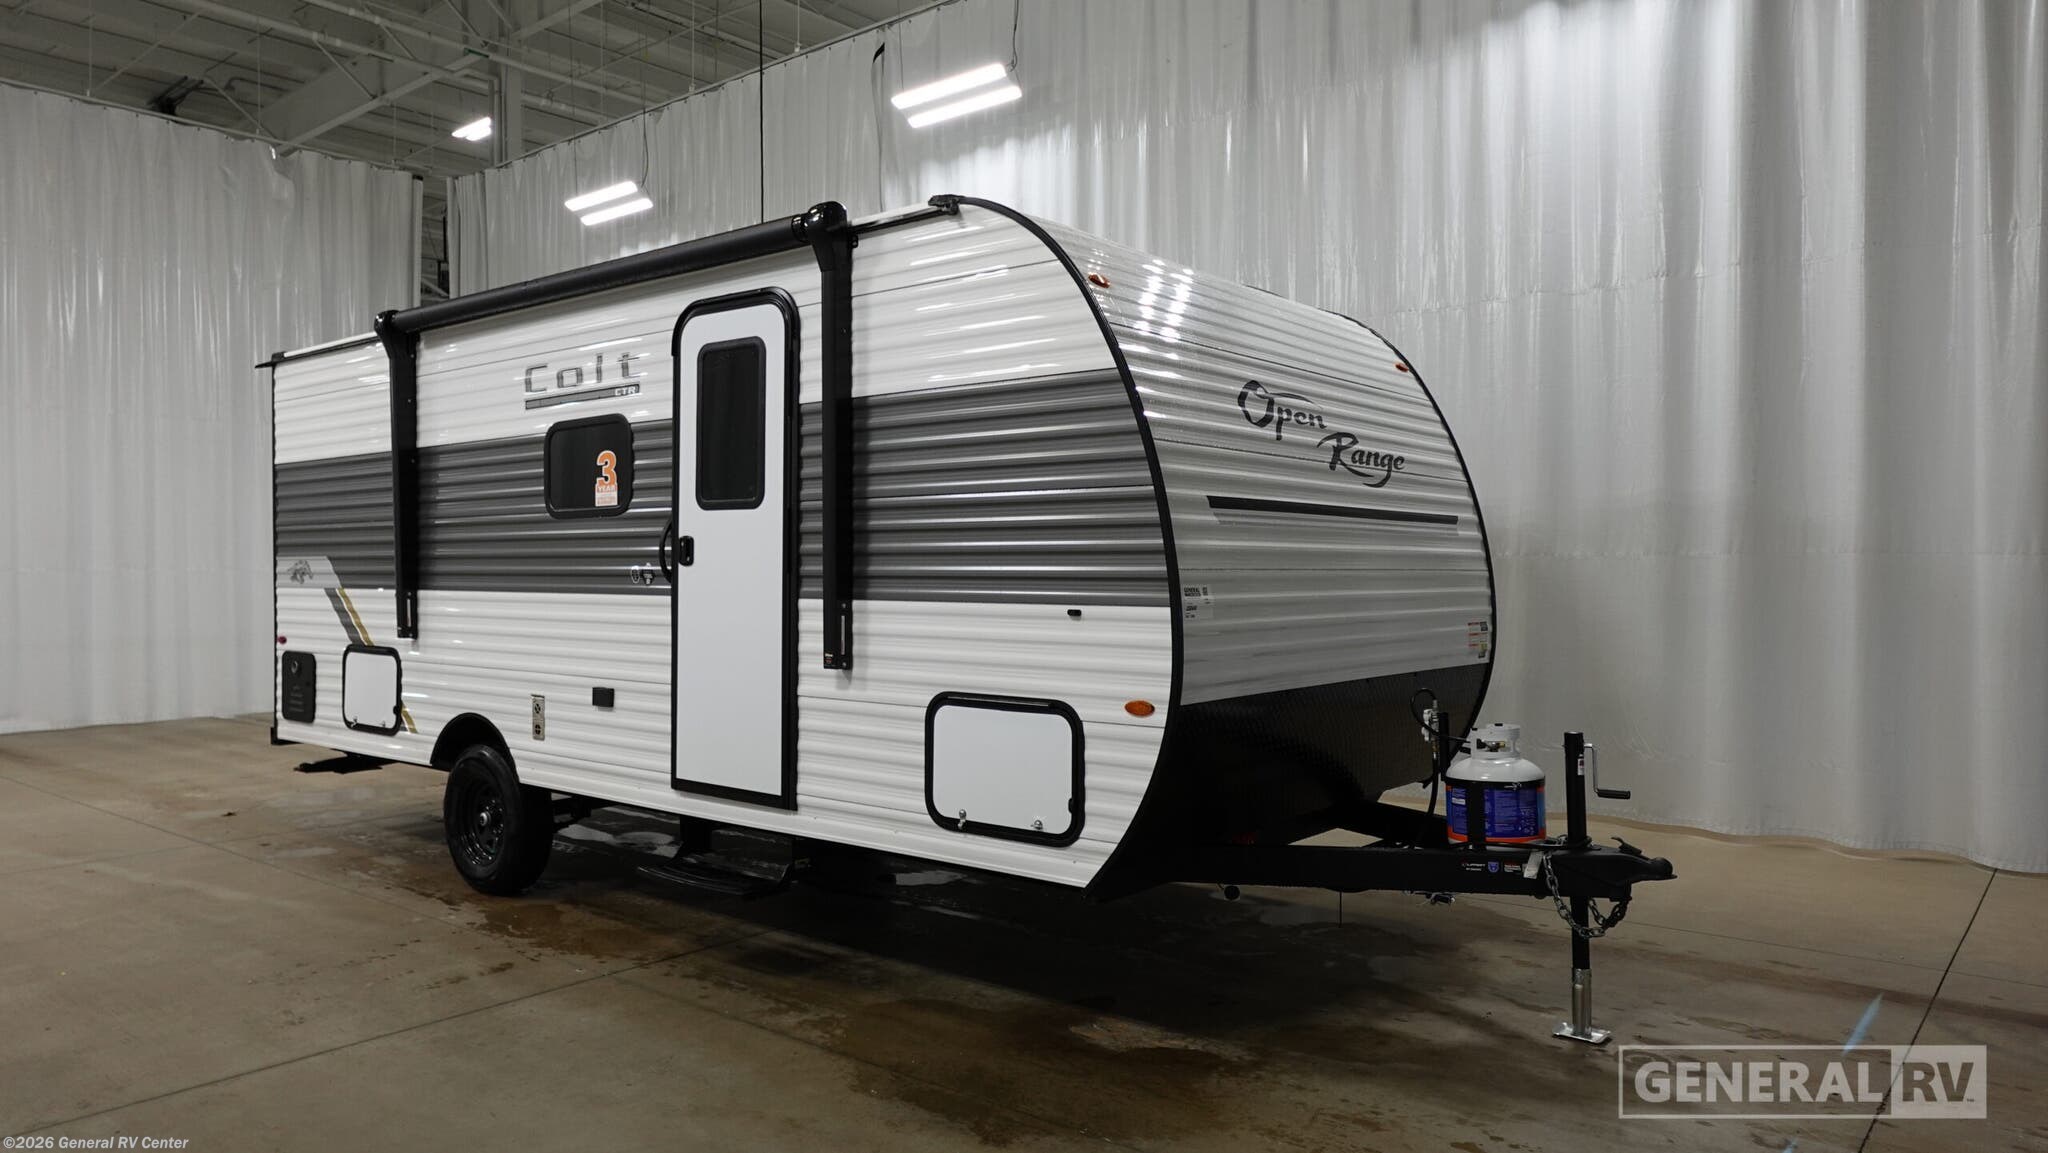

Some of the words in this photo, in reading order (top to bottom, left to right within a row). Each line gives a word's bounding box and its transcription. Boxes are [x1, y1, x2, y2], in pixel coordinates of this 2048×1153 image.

[524, 352, 640, 393] Colt
[615, 386, 636, 396] CTR
[1237, 380, 1328, 441] Open
[596, 450, 617, 486] 3
[1316, 431, 1406, 489] Range
